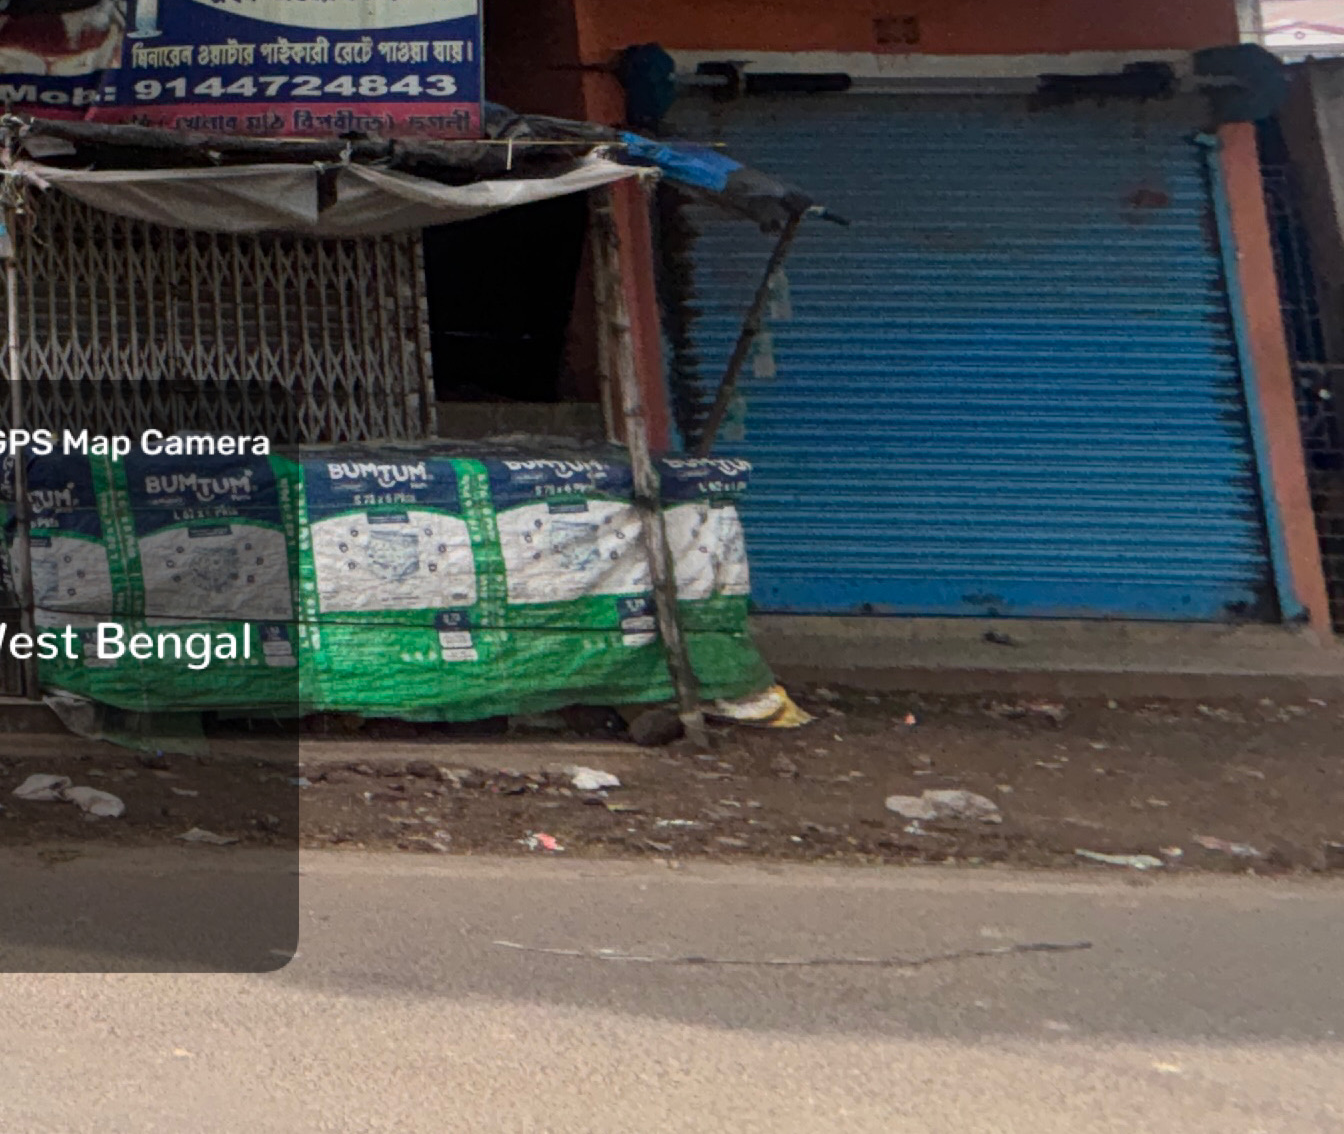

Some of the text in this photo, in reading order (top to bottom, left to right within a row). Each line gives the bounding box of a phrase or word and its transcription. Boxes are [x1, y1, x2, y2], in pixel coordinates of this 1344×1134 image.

[260, 36, 329, 65] পাইকারী
[133, 73, 459, 100] 9144724843
[145, 470, 252, 502] BUMTUM
[327, 462, 427, 488] BUMTUM
